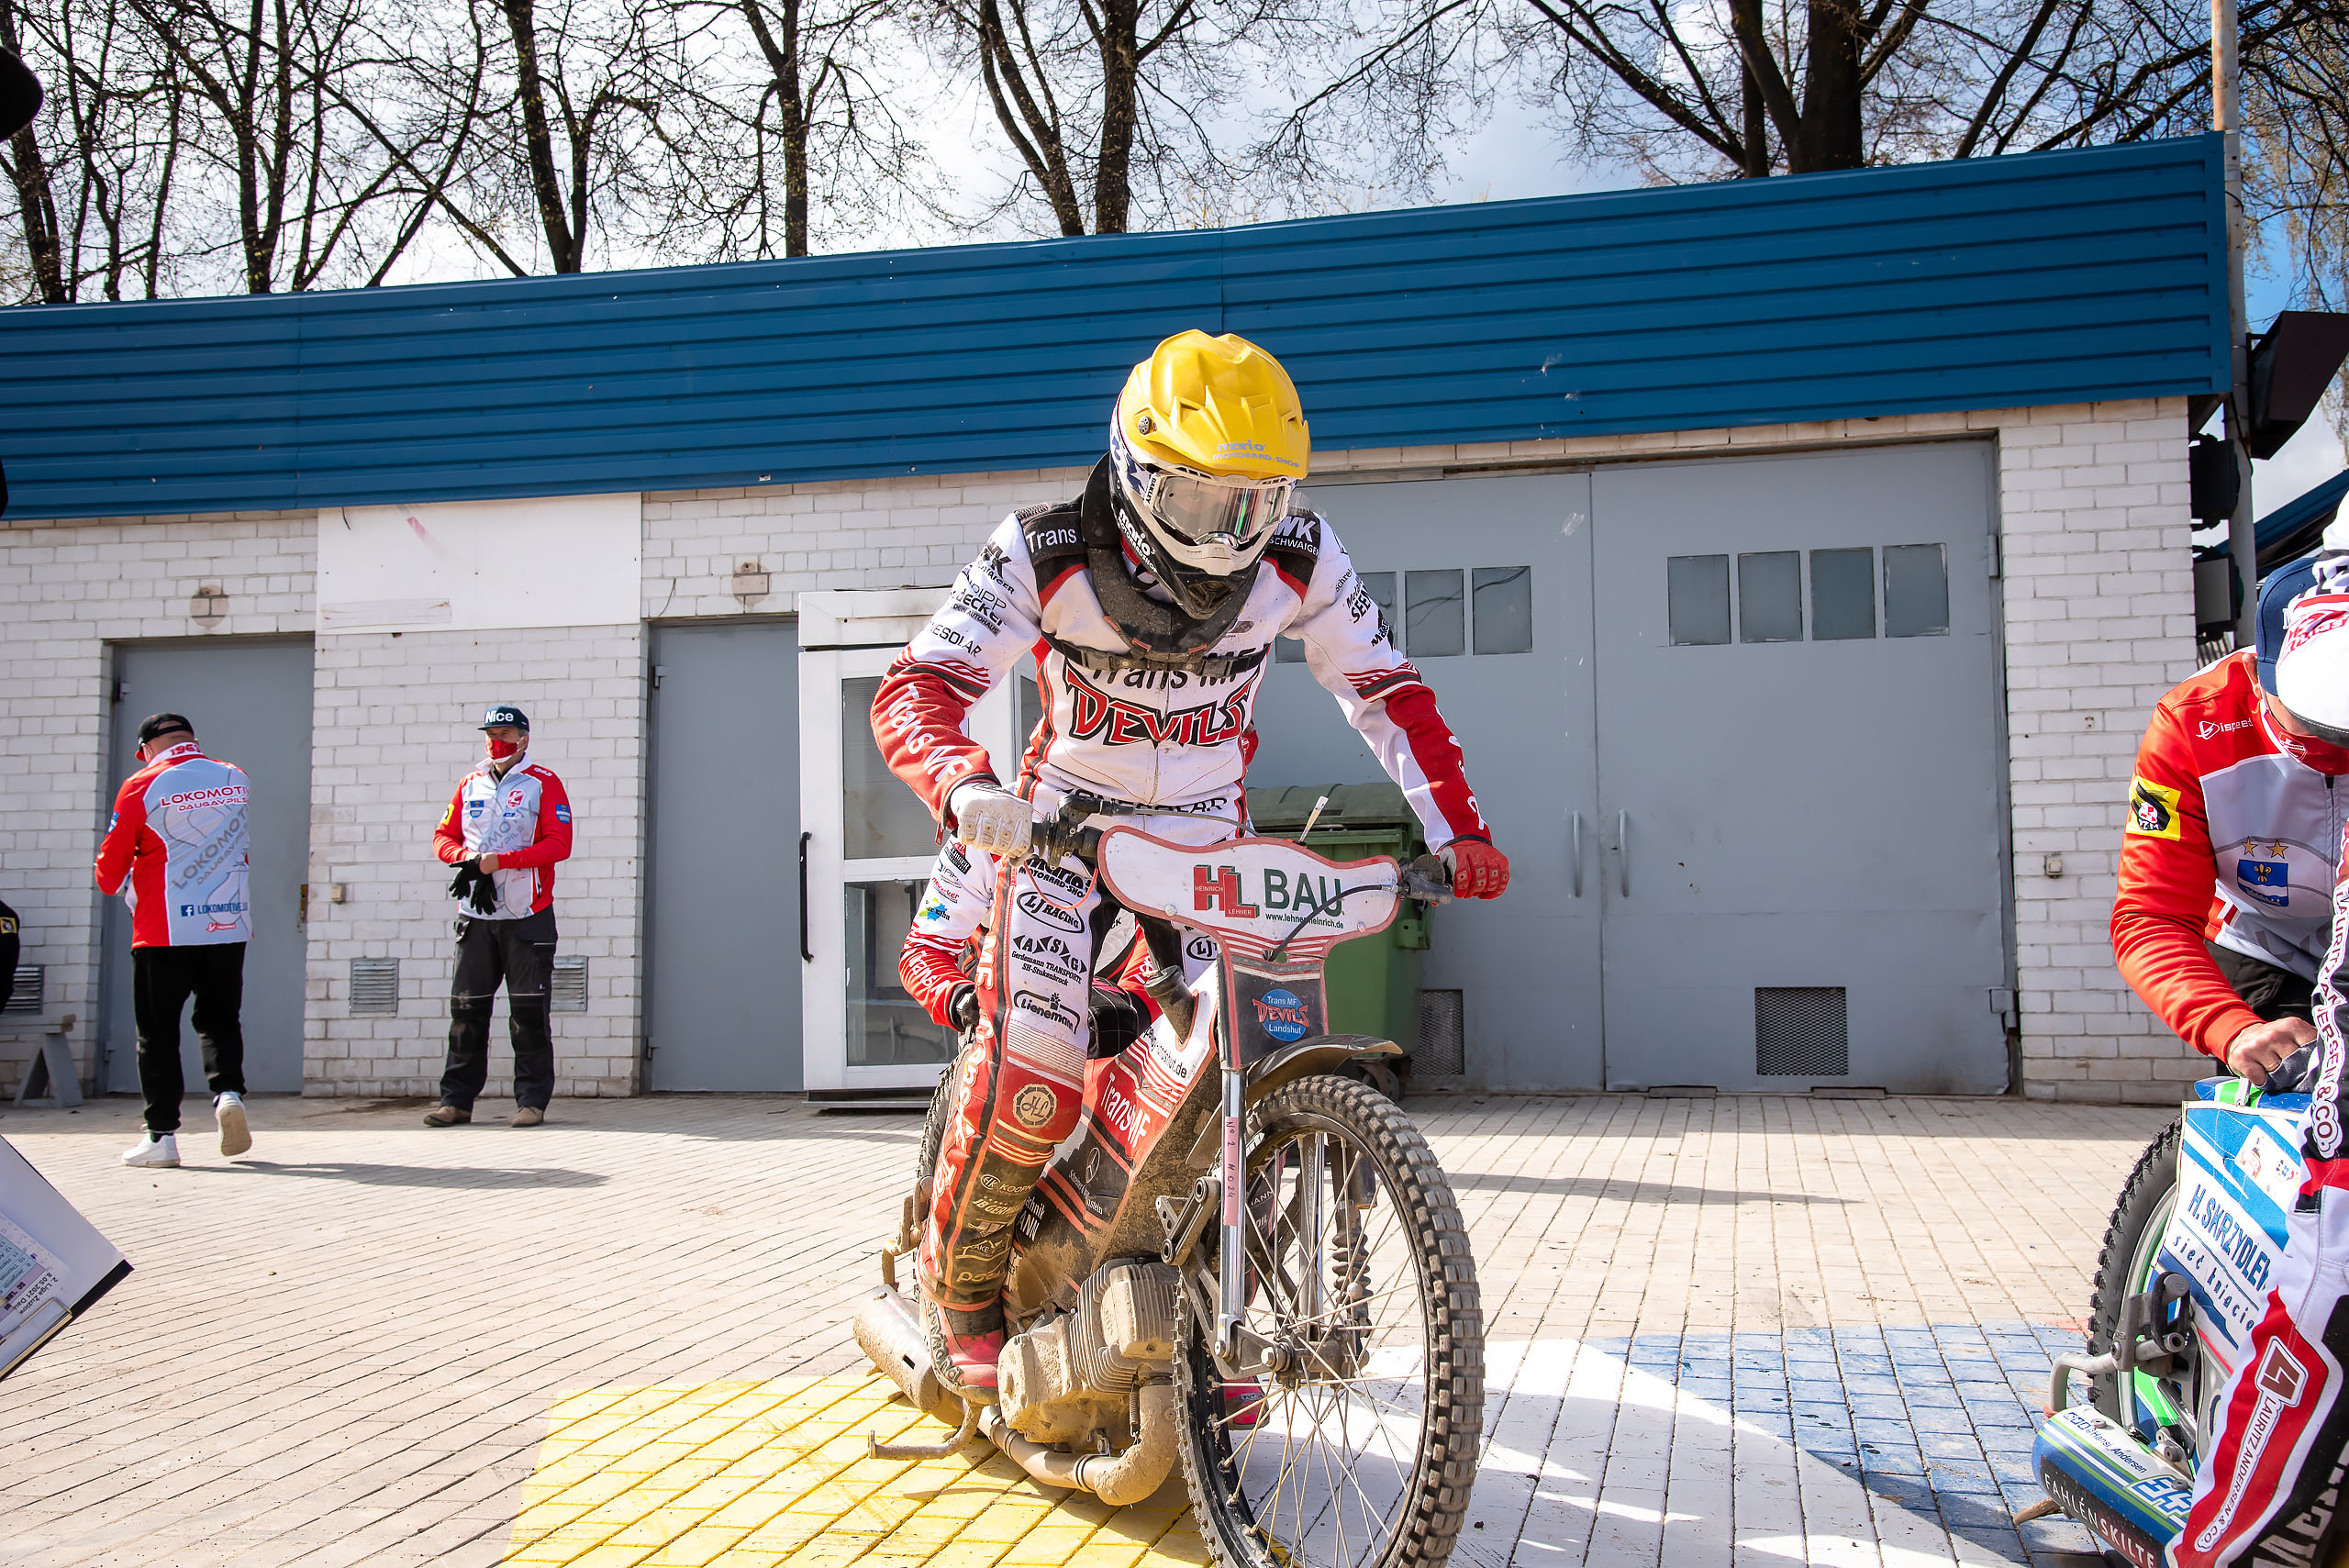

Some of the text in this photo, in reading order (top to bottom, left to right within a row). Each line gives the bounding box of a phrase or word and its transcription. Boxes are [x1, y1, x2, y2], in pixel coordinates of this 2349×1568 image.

[1147, 478, 1156, 504] OAKLEY
[1026, 528, 1077, 553] Trans
[967, 611, 1000, 636] AUTOHAUS
[1063, 656, 1261, 750] DEVILS
[484, 710, 514, 724] Nice
[1264, 868, 1342, 917] BAU
[1042, 904, 1079, 929] RACING
[1012, 951, 1082, 984] Gerdemann TRANSPORTE
[1021, 963, 1069, 986] SH-Stukenbrock
[1252, 998, 1309, 1028] DEVILS
[1267, 996, 1297, 1006] Trans MF
[1020, 998, 1074, 1032] Lienemann
[1268, 1023, 1301, 1034] Landshut
[2250, 1396, 2277, 1452] LAURITZ
[2224, 1449, 2254, 1523] ANDERSEN
